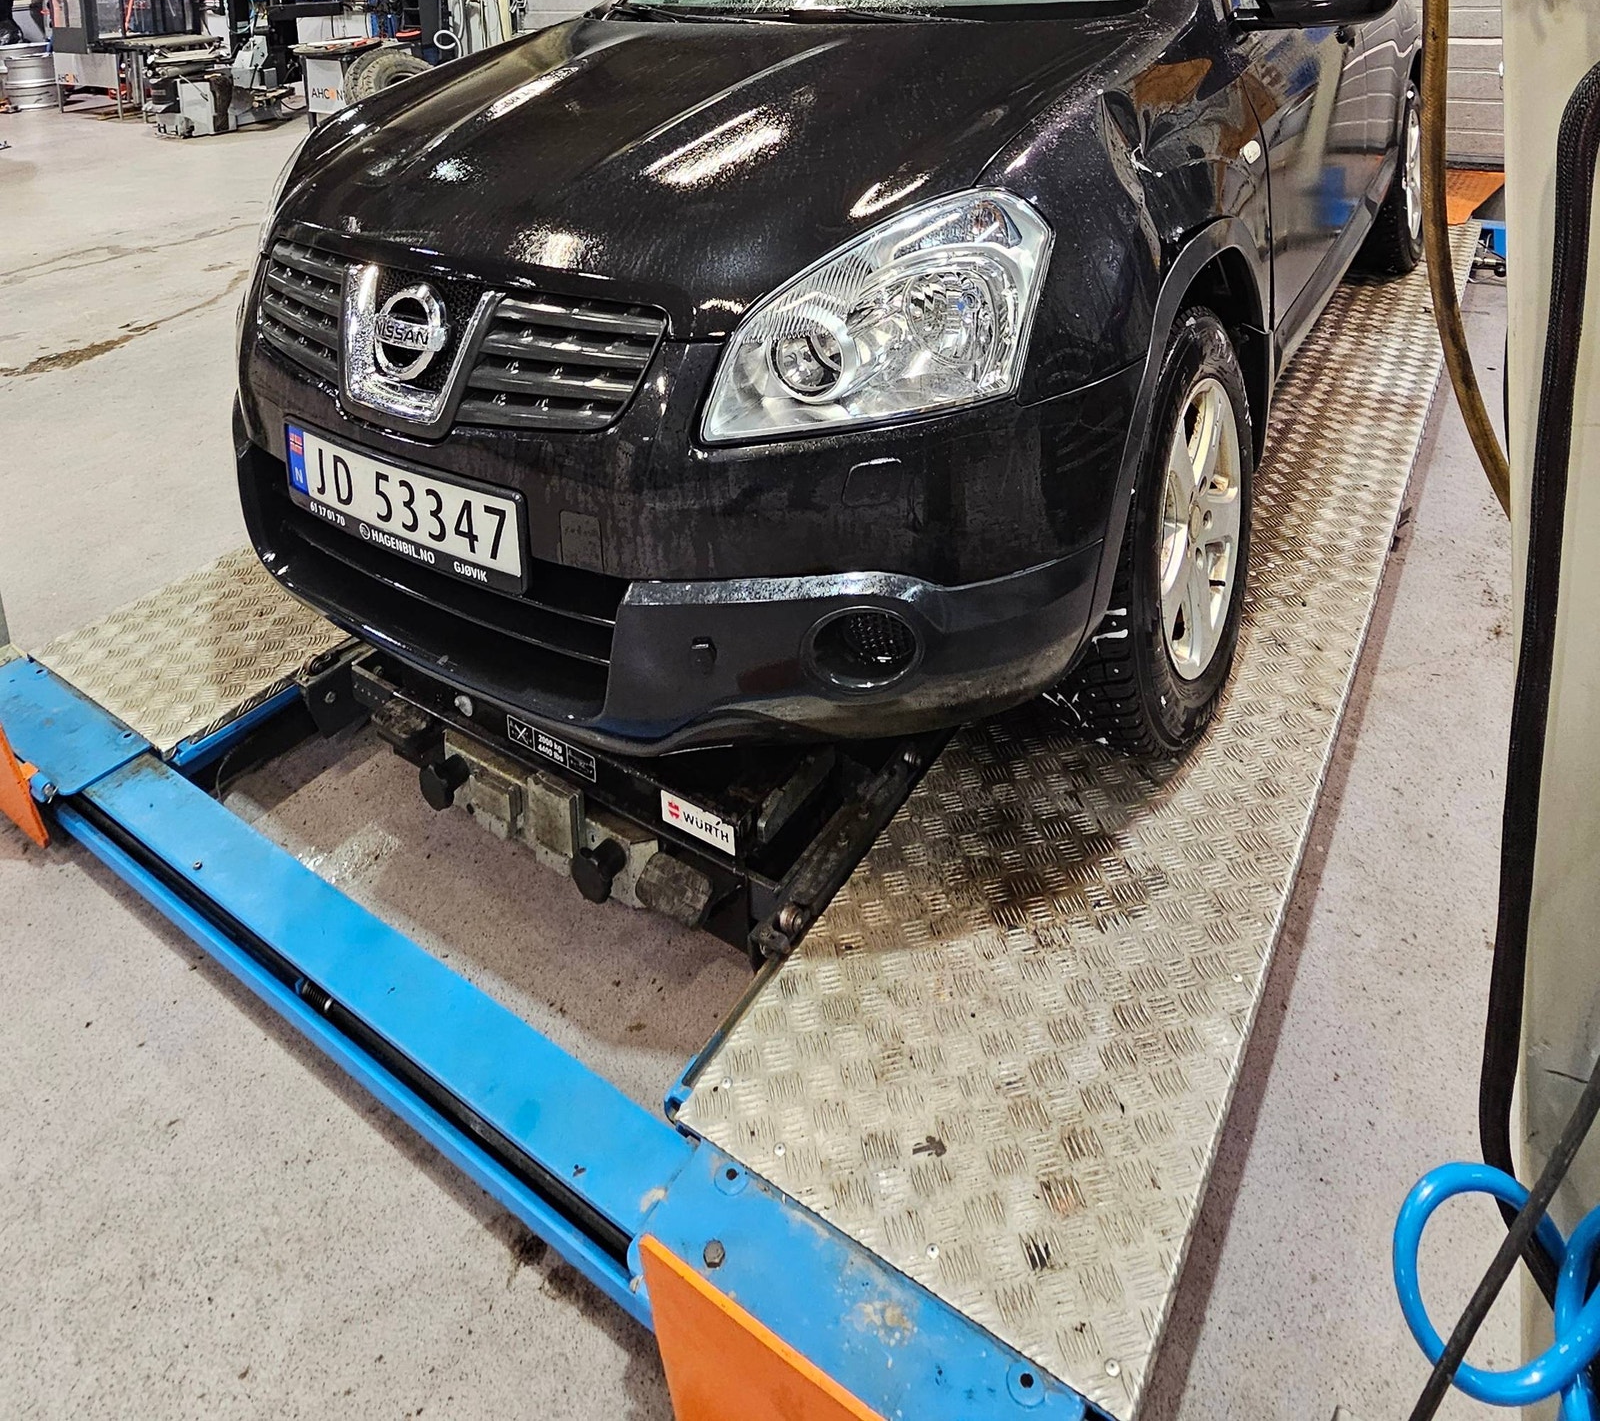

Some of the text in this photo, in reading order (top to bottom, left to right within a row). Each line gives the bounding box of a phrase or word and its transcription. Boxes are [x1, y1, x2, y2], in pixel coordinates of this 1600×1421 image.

[374, 319, 429, 345] NISSAN
[294, 466, 304, 483] N
[317, 448, 507, 560] JD 53347
[371, 529, 435, 564] HAGENBIL.NO
[453, 561, 488, 583] GJØVIK
[538, 734, 563, 754] 2000 kg
[683, 810, 729, 843] WÜRTH
